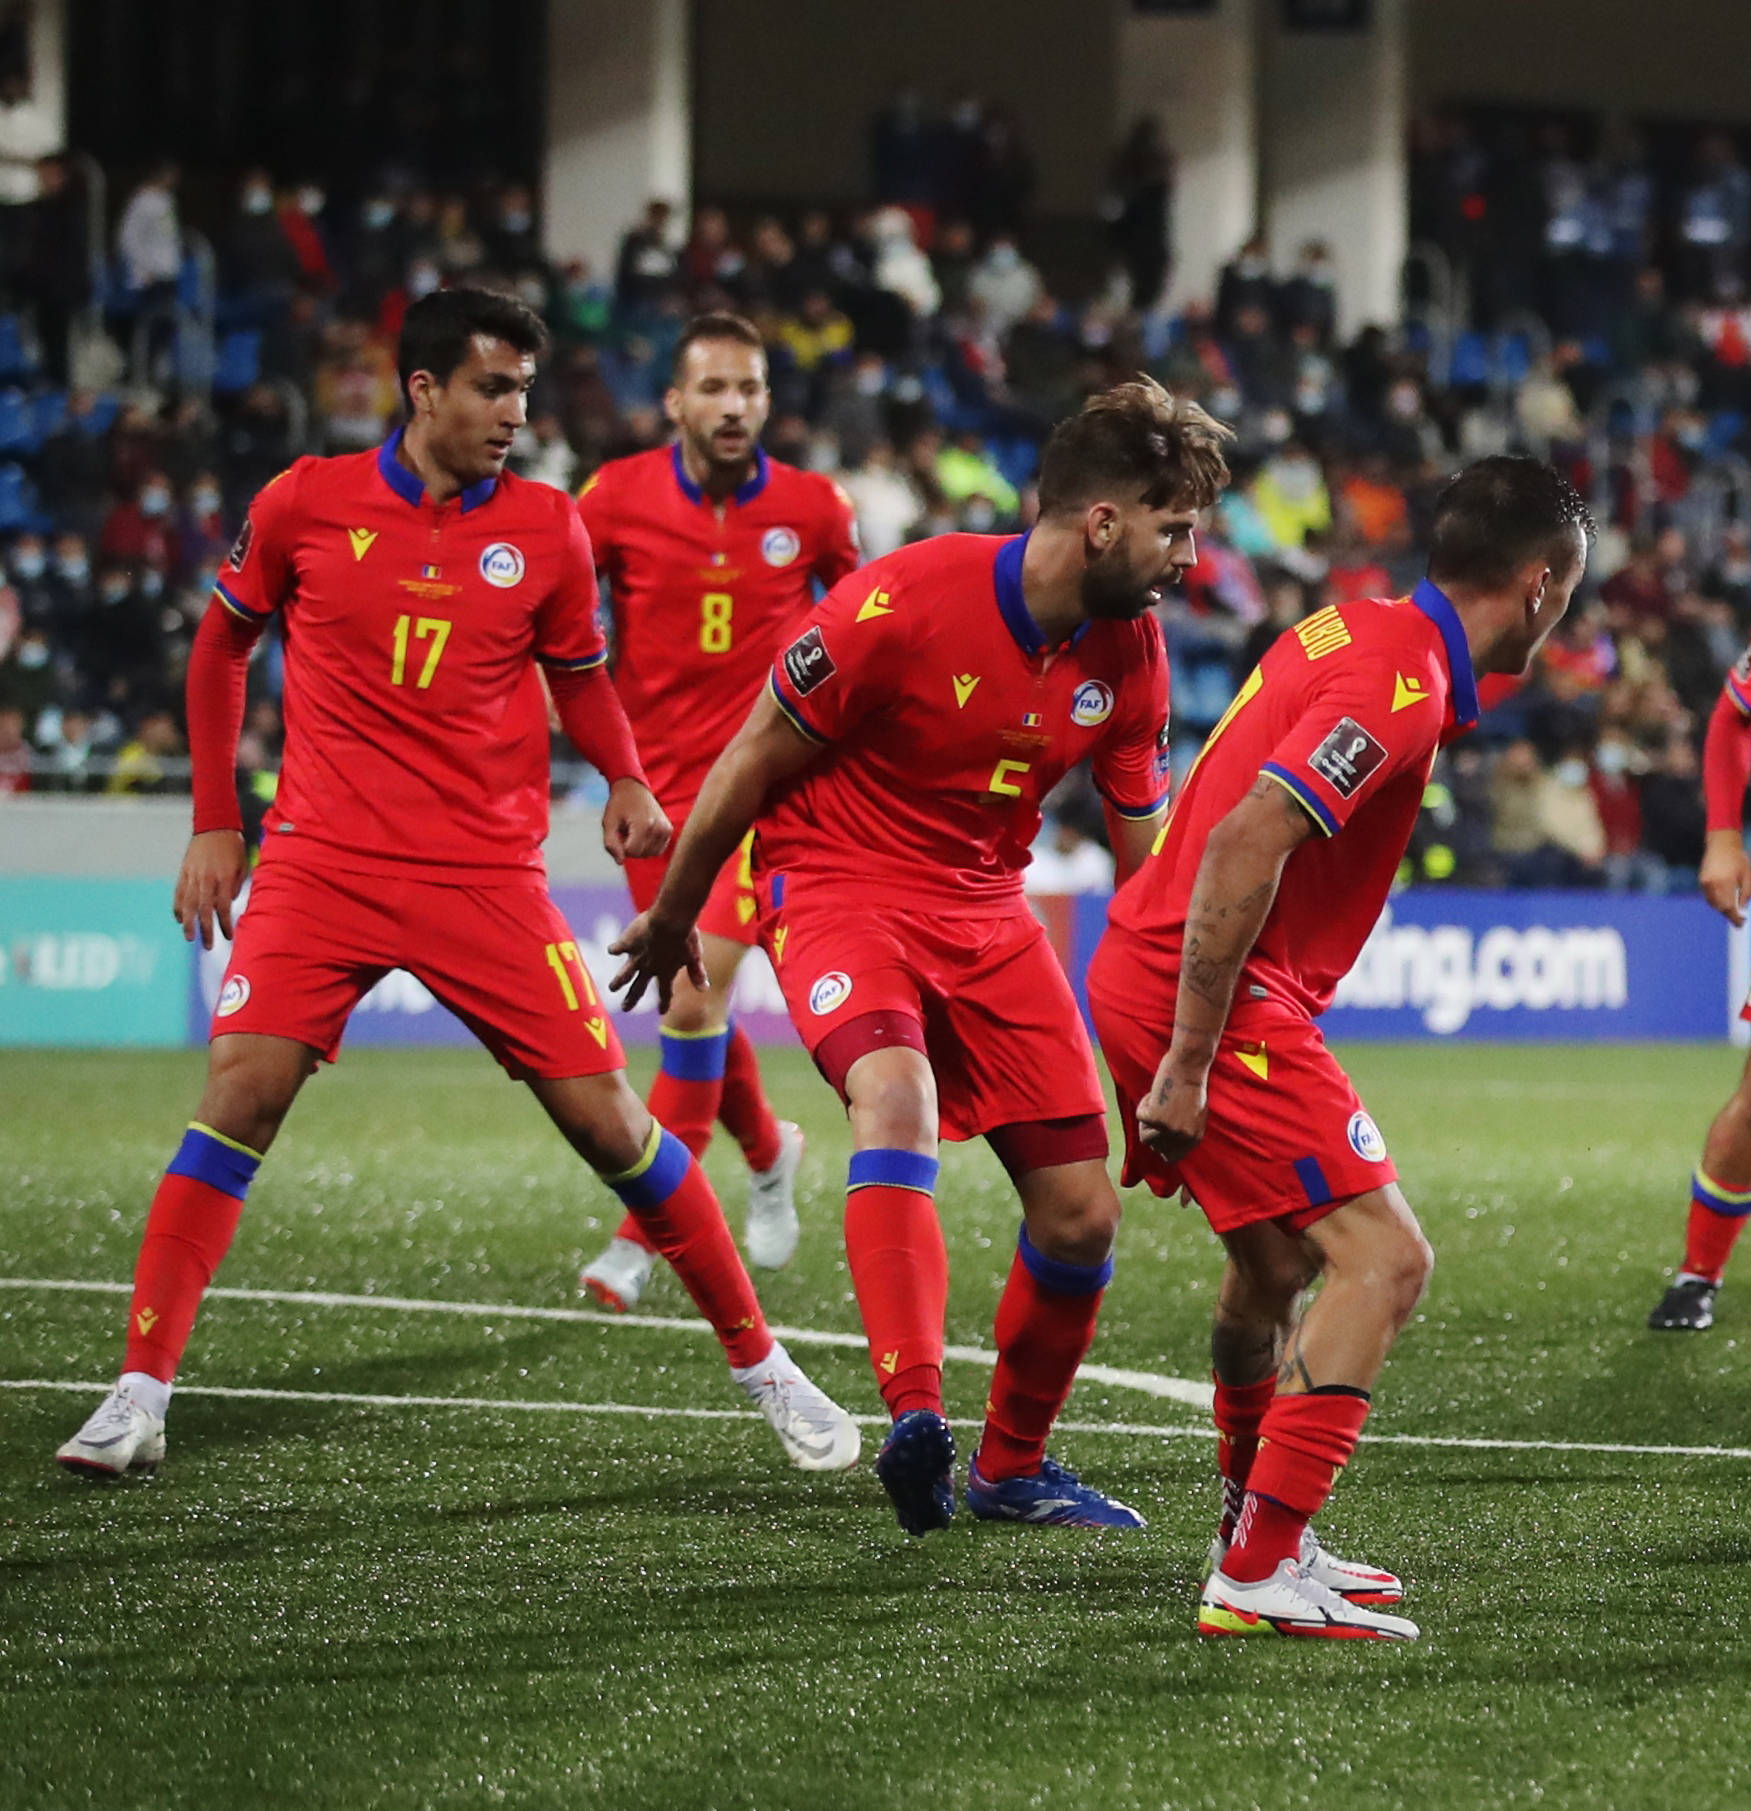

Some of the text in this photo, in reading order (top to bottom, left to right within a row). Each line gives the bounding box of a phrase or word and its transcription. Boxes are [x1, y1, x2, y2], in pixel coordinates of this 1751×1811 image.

[391, 614, 453, 689] 17
[701, 591, 733, 654] 8
[1079, 699, 1101, 710] FAF
[545, 941, 599, 1011] 17
[1333, 902, 1629, 1035] ing.com
